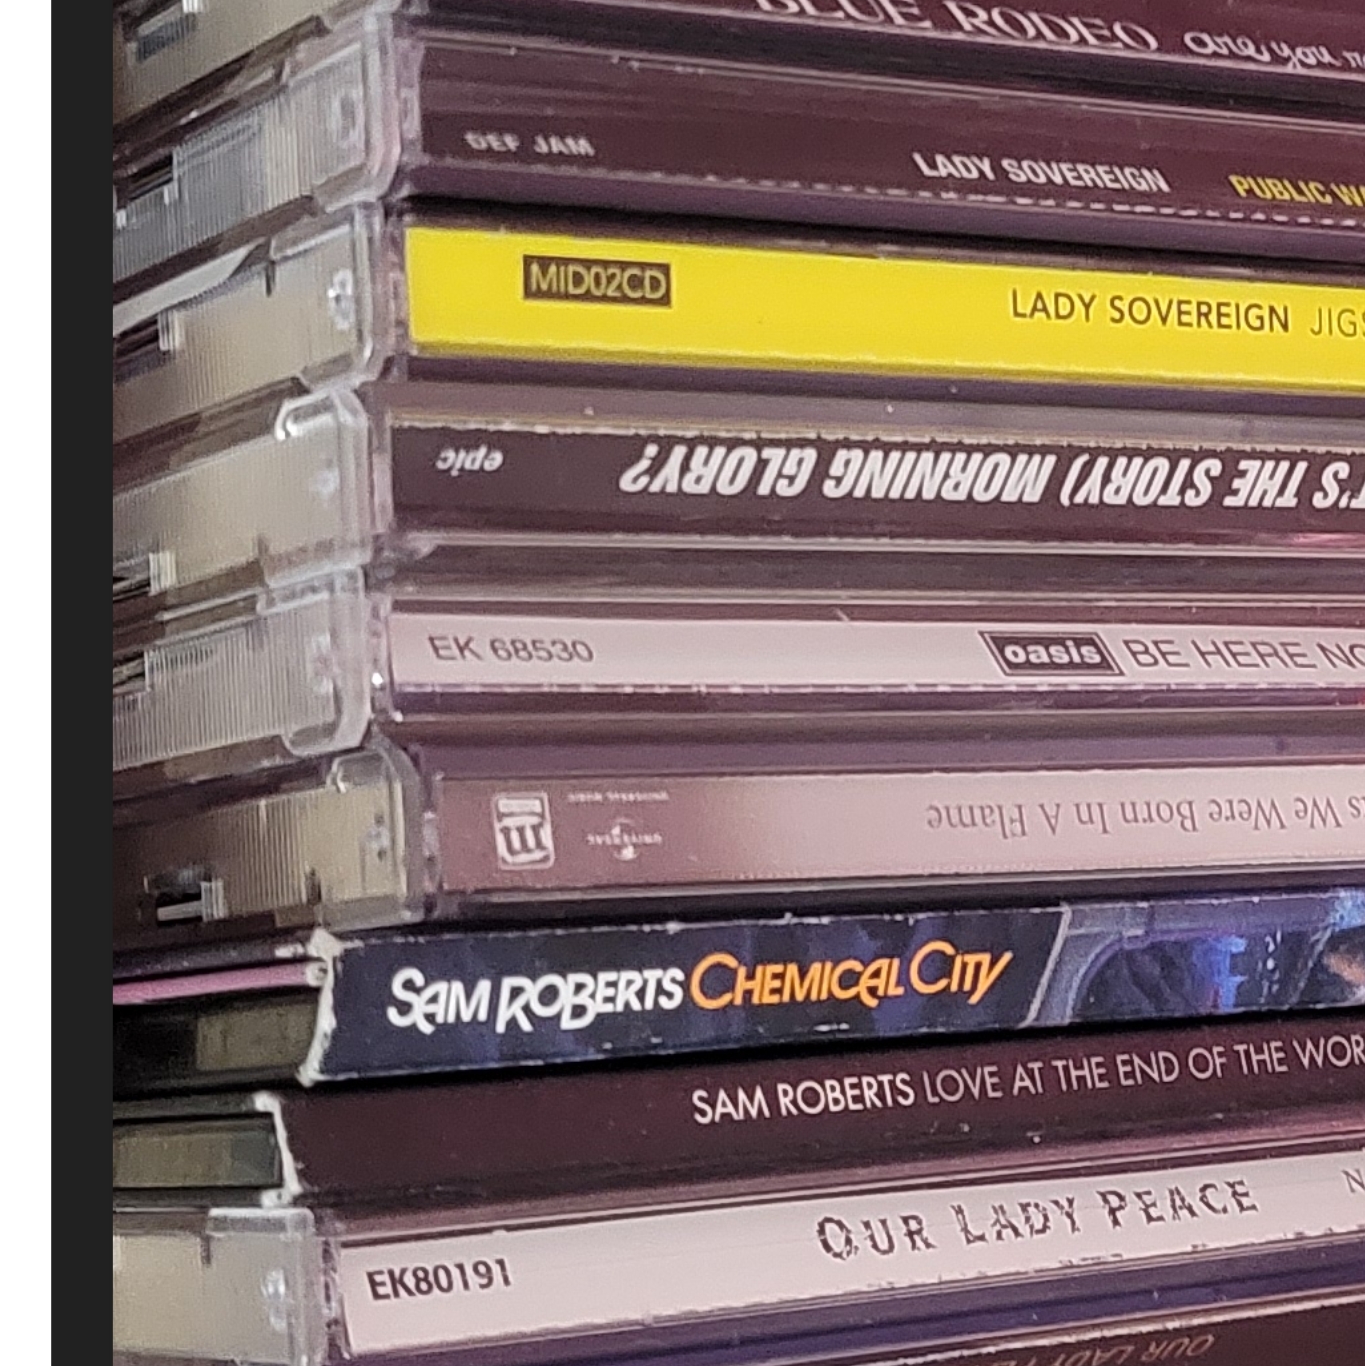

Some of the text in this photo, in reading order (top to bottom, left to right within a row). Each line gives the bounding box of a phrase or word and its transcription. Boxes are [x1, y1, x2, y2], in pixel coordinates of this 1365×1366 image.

[464, 130, 522, 154] DEF
[531, 133, 596, 158] JAM
[912, 150, 996, 183] LADY
[1000, 156, 1170, 194] SOVEREIGN
[1228, 173, 1334, 208] PUBLIC
[1010, 287, 1097, 324] LADY
[1108, 294, 1291, 335] SOVEREIGN
[434, 446, 504, 477] epic
[617, 443, 818, 495] GLORY?
[822, 446, 1058, 504] MORNING
[1059, 454, 1223, 508] STORY)
[1222, 458, 1310, 509] THE
[428, 635, 484, 662] EK
[489, 637, 595, 664] 68530
[1003, 639, 1102, 666] oasis
[1121, 638, 1196, 669] BE
[1190, 639, 1320, 671] HERE
[926, 801, 1027, 840] Flame
[1075, 801, 1110, 834] In
[1120, 799, 1199, 833] Born
[1208, 797, 1288, 832] Were
[1294, 795, 1343, 829] We
[386, 939, 1014, 1034] SAM ROBERTS CHEMICAL CITY
[691, 1086, 772, 1126] SAM
[775, 1072, 915, 1118] ROBERTS
[920, 1064, 1004, 1104] LOVE
[1011, 1061, 1045, 1097] AT
[1050, 1055, 1110, 1092] THE
[1116, 1049, 1180, 1087] END
[1187, 1046, 1228, 1080] OF
[1231, 1040, 1289, 1076] THE
[365, 1257, 513, 1303] EK80191
[815, 1212, 939, 1262] OUR
[1096, 1178, 1260, 1229] PEACE
